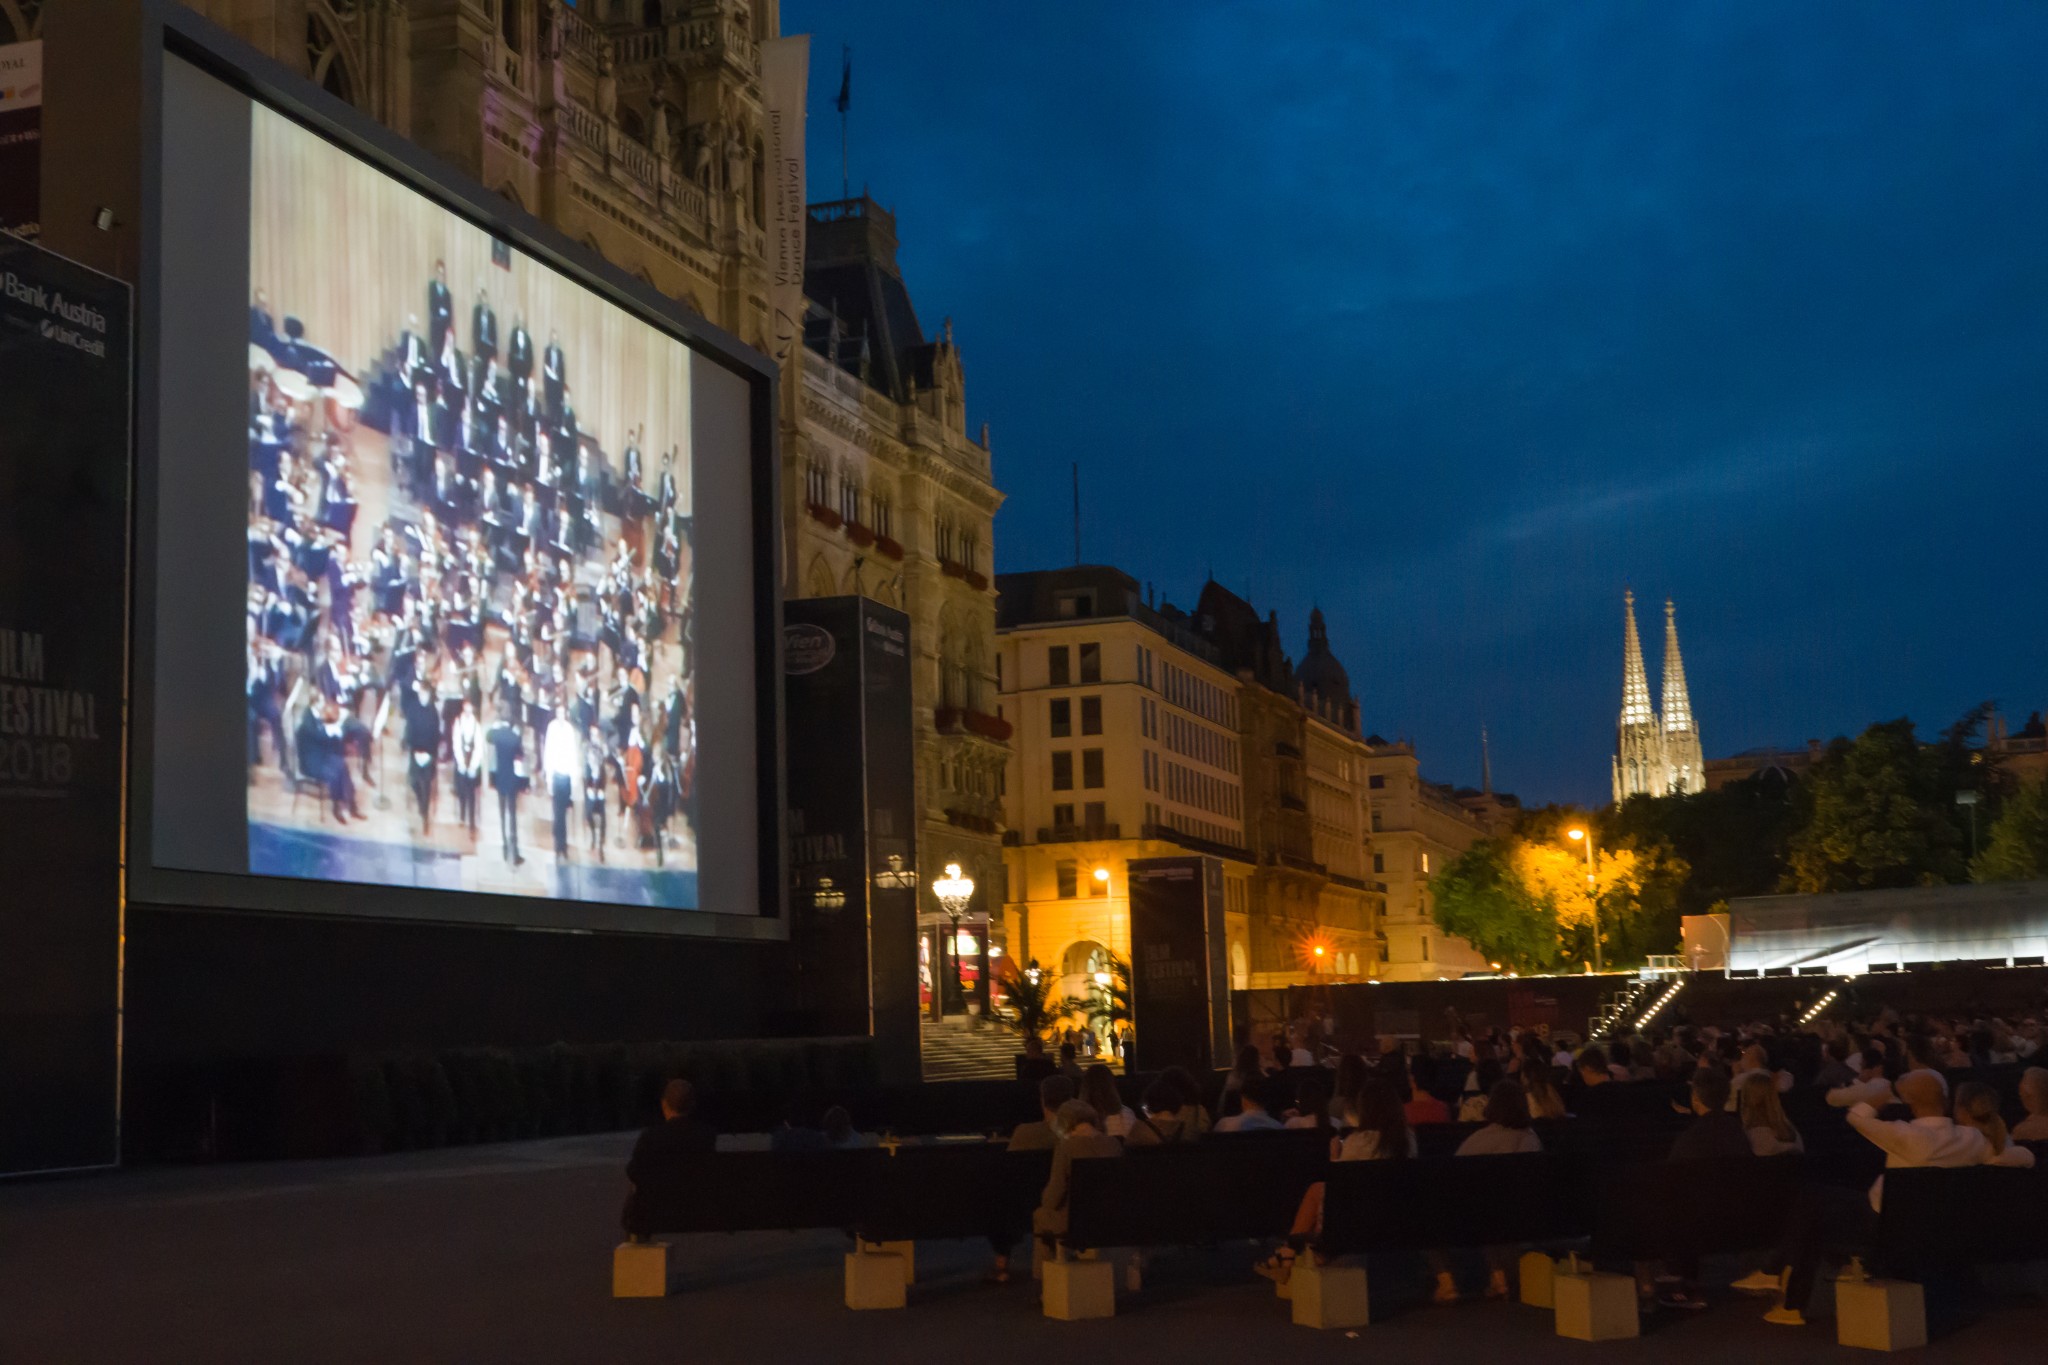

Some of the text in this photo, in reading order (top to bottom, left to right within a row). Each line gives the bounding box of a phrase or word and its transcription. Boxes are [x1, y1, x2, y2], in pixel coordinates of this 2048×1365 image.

[769, 110, 789, 286] Vienna International
[784, 158, 801, 285] Dance Festival
[5, 271, 48, 312] Bank
[51, 292, 106, 334] Austria
